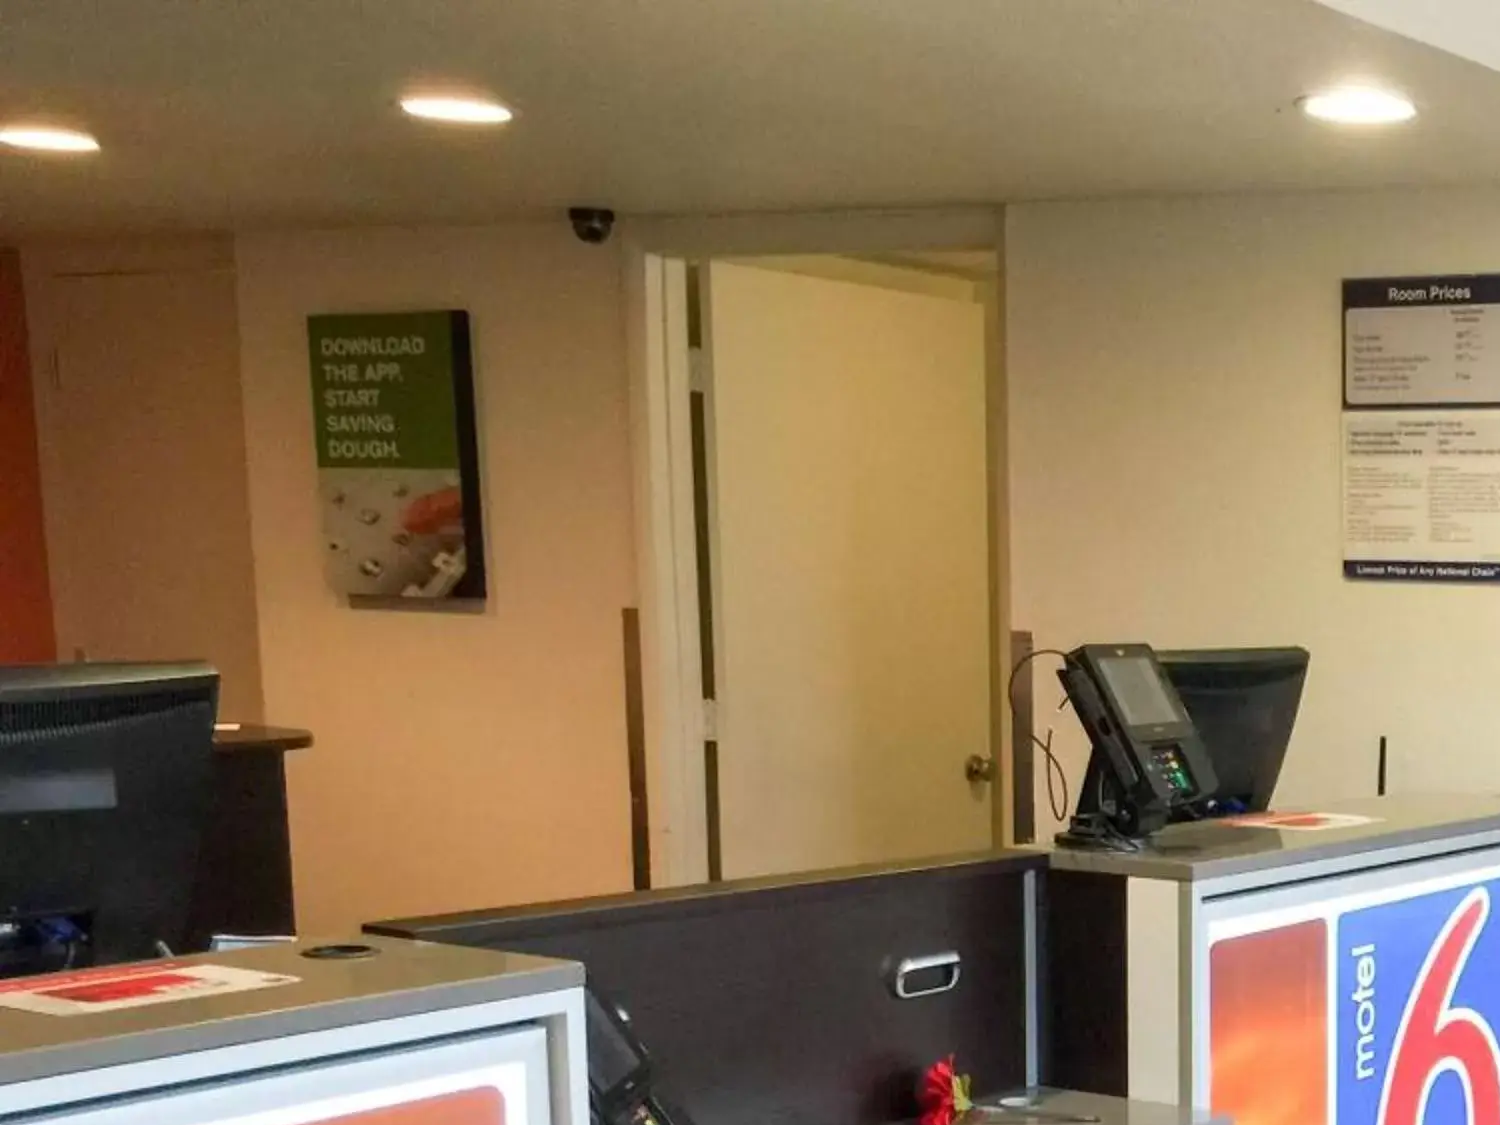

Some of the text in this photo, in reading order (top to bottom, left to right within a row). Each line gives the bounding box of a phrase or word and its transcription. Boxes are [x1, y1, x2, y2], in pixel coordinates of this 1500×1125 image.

[1388, 284, 1471, 301] Room Prices
[321, 335, 425, 356] DOWNLOAD
[322, 363, 359, 382] THE
[323, 388, 380, 408] START
[326, 413, 395, 433] SAVING
[1351, 943, 1376, 1080] motel
